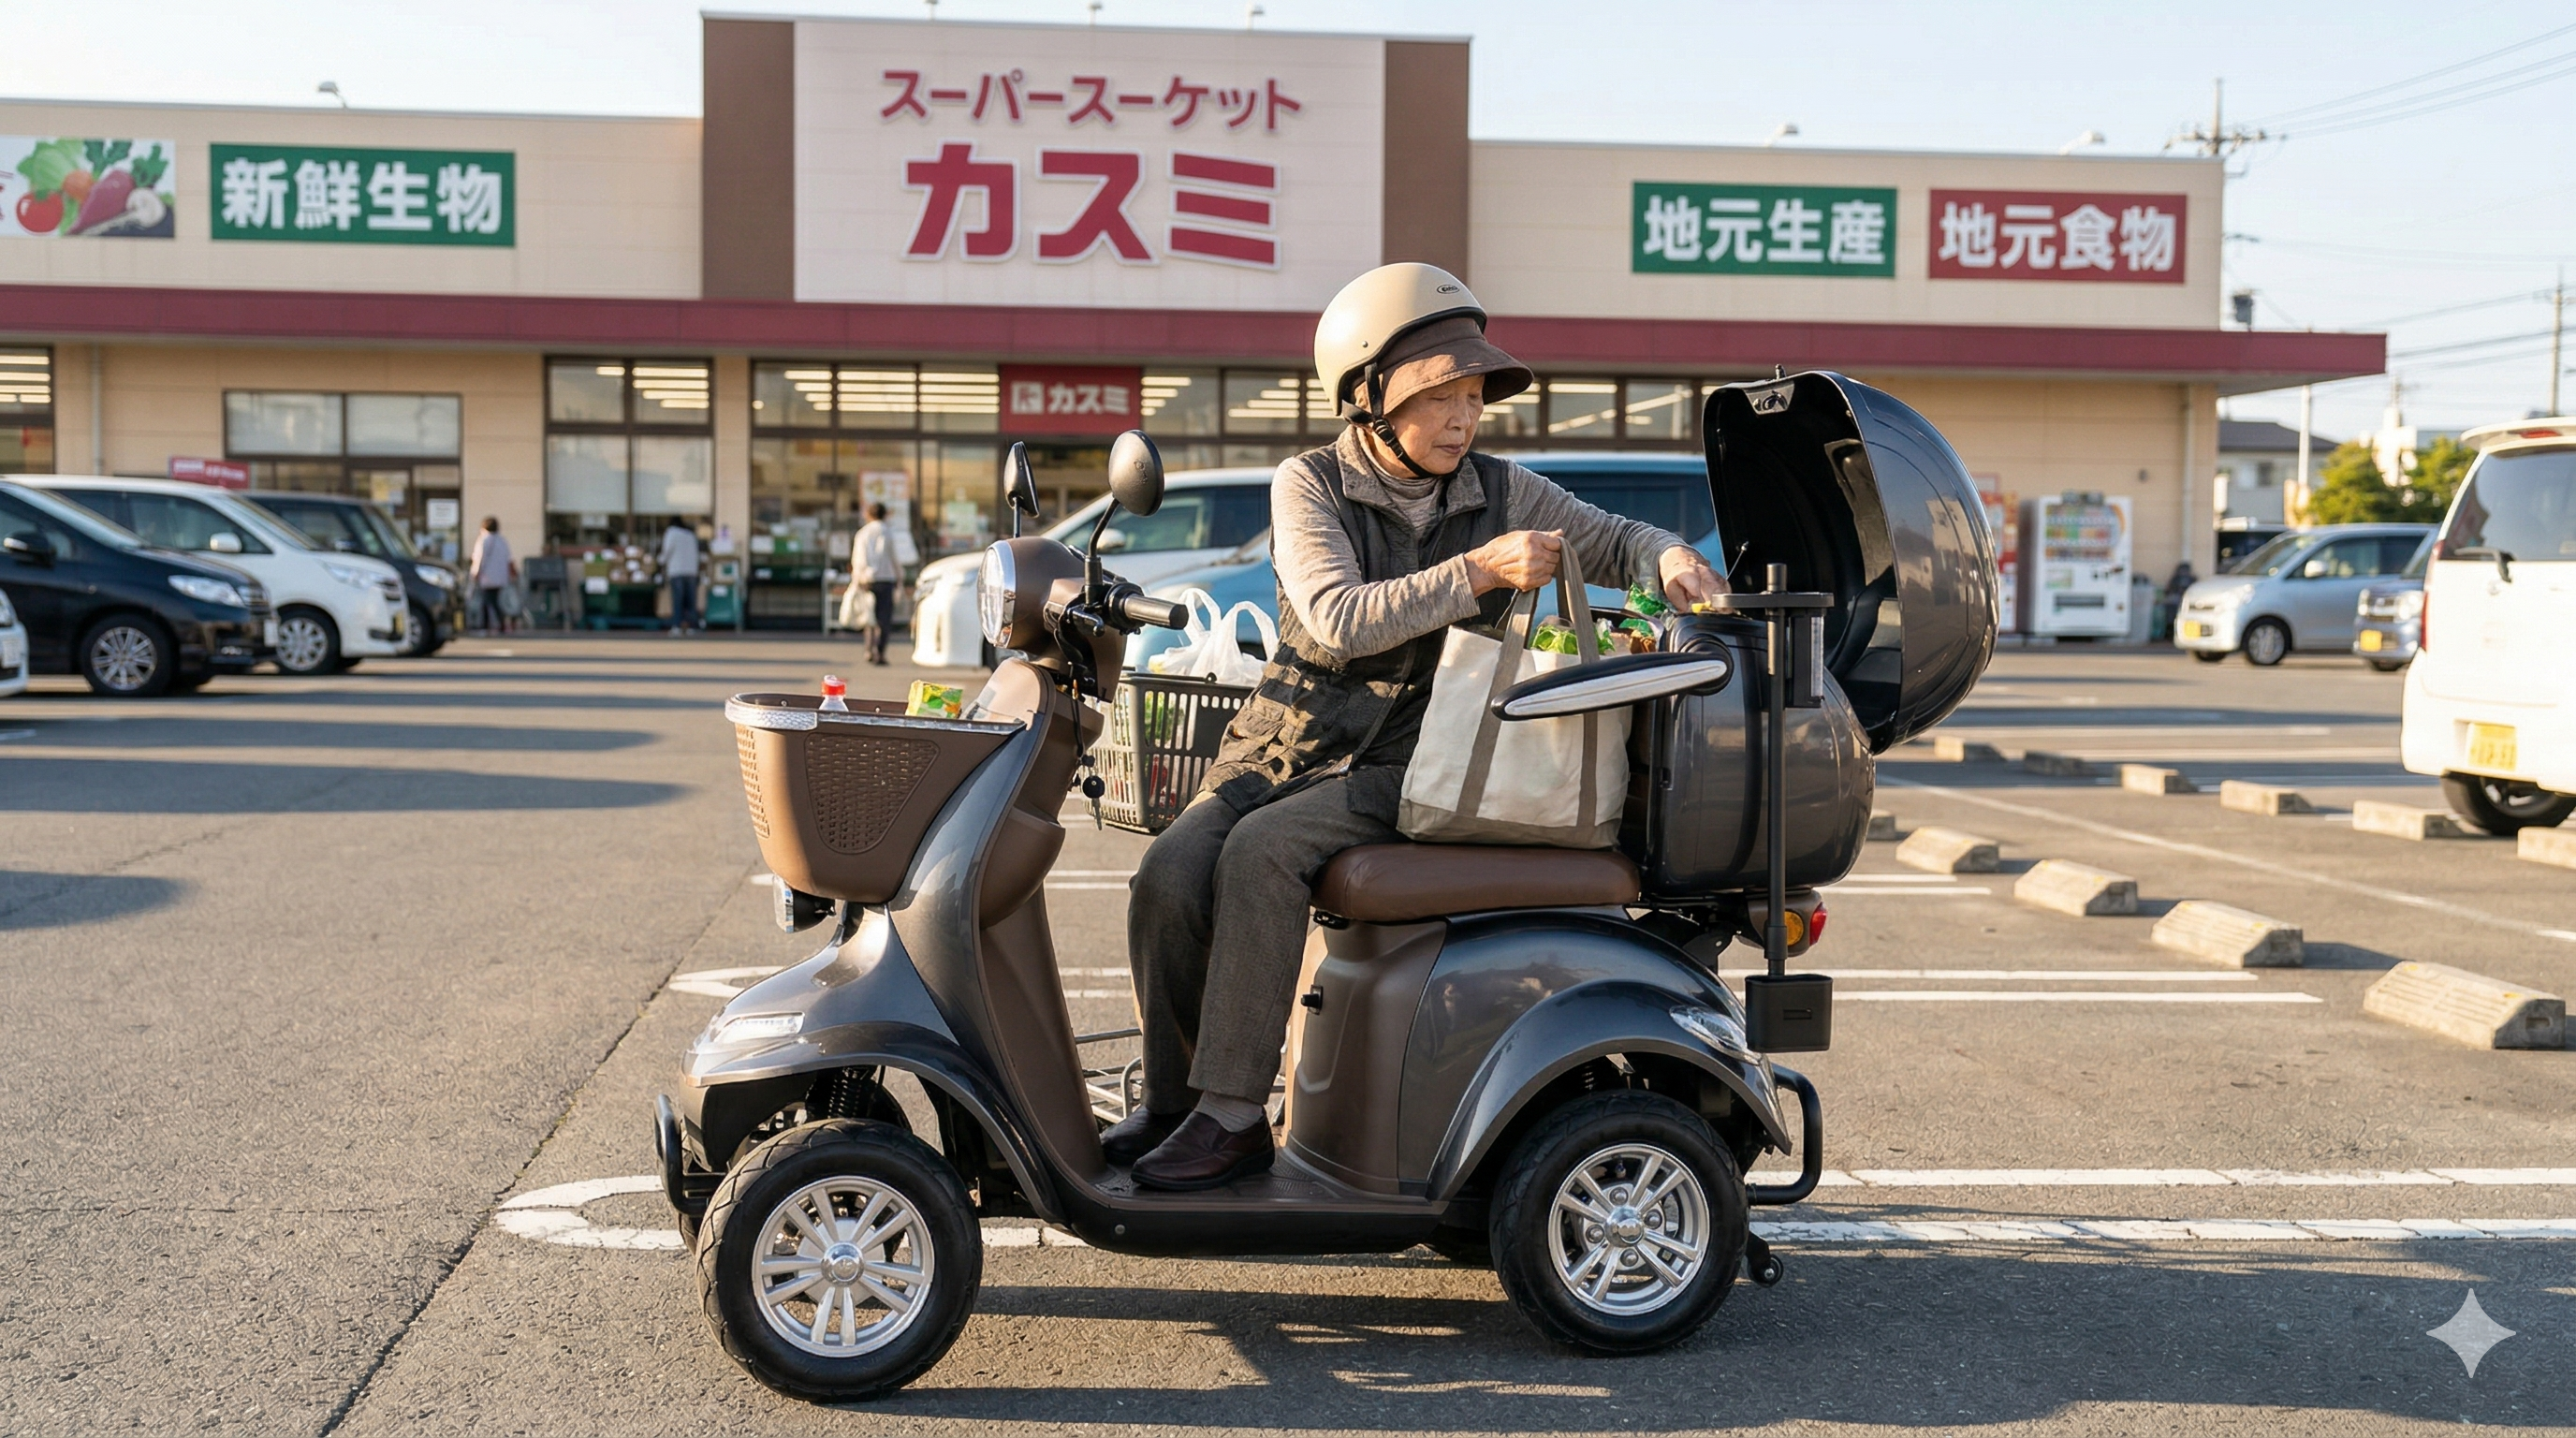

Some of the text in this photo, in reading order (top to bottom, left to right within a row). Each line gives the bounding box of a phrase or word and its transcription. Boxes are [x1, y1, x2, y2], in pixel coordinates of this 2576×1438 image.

[880, 68, 1301, 130] スーパースーケット
[222, 157, 503, 234] 新鮮生物
[904, 141, 1277, 267] カスミ
[1643, 195, 1886, 264] 地元生産
[1938, 201, 2176, 271] 地元食物
[1047, 382, 1130, 416] カスミ
